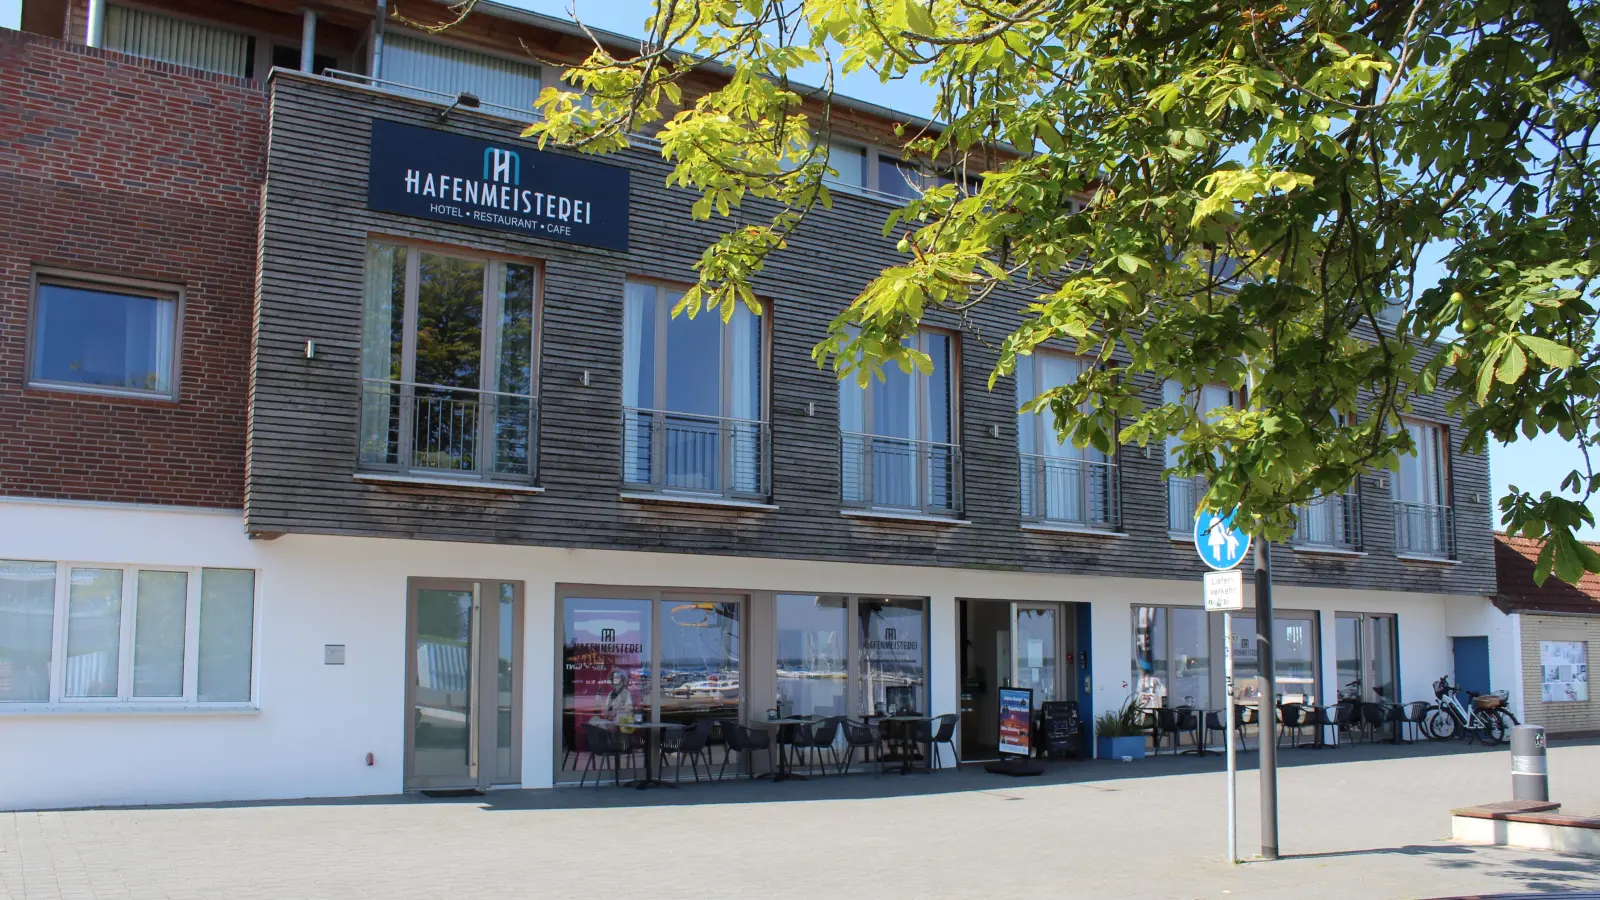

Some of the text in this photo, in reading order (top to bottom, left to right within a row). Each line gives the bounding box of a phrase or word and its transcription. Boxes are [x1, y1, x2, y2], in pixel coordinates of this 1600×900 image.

[404, 169, 591, 225] HAFENMEISTEREI
[430, 203, 571, 236] HOTEL RESTAURANT CAFE
